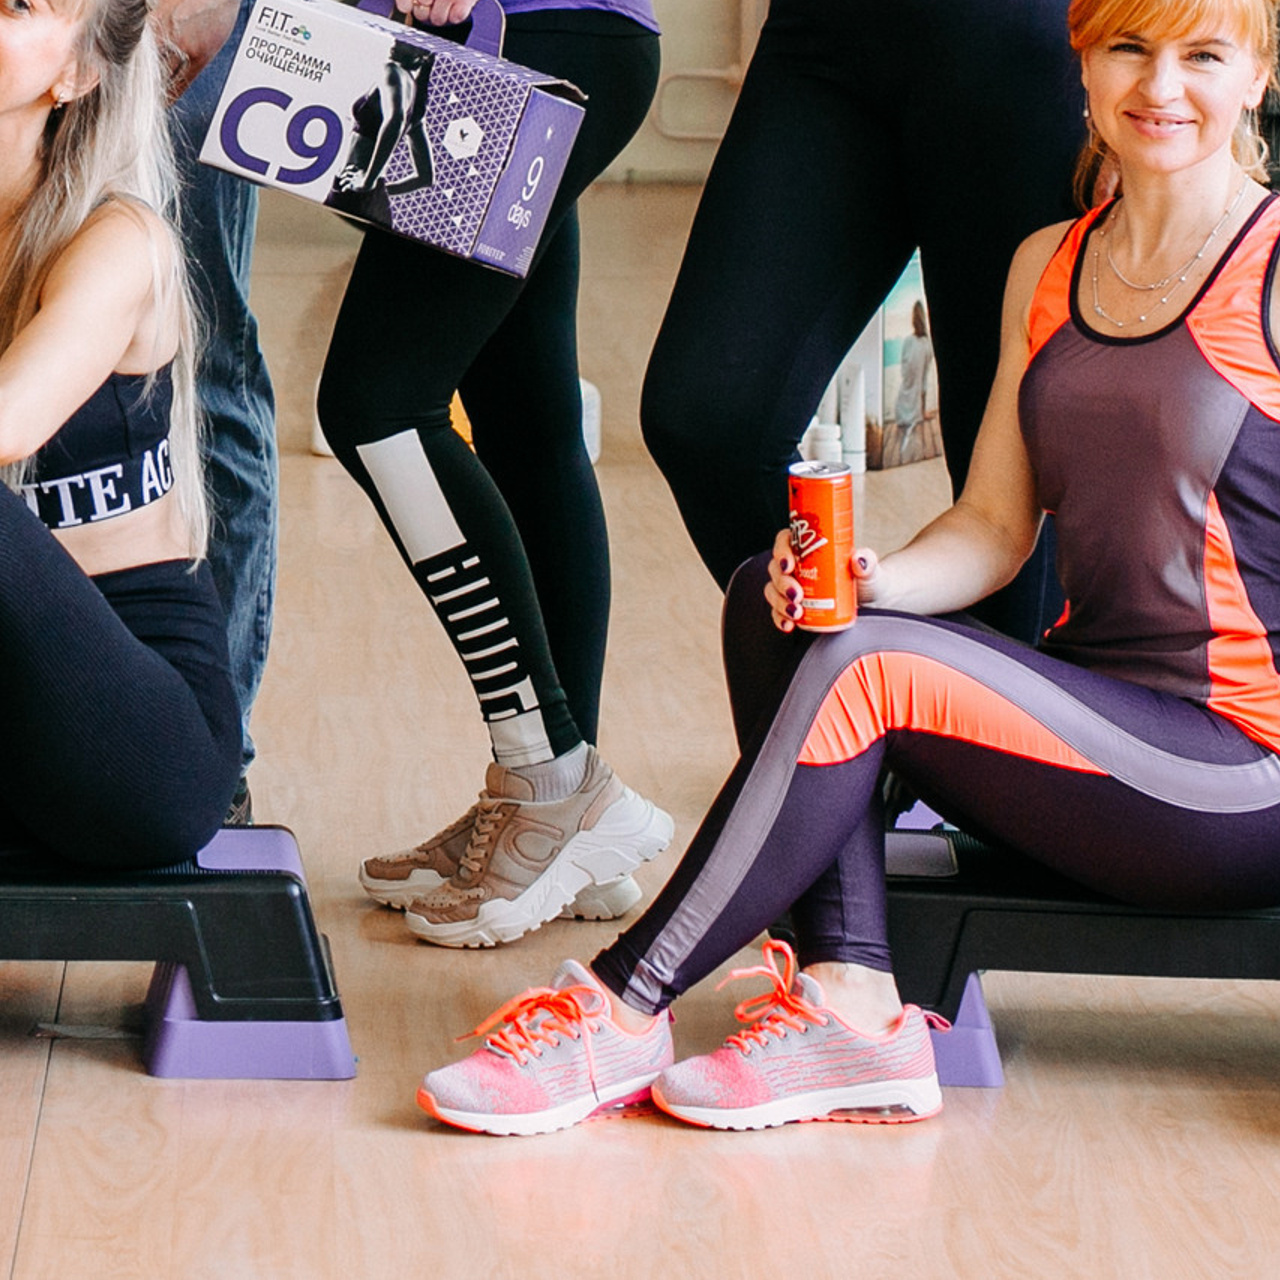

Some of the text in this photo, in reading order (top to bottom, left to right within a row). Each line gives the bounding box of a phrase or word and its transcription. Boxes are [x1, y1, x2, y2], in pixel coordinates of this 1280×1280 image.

[245, 48, 325, 83] ОЧИЩЕНИЯ
[248, 36, 333, 74] ПРОГРАММА
[219, 87, 344, 185] C9
[521, 156, 545, 202] 9
